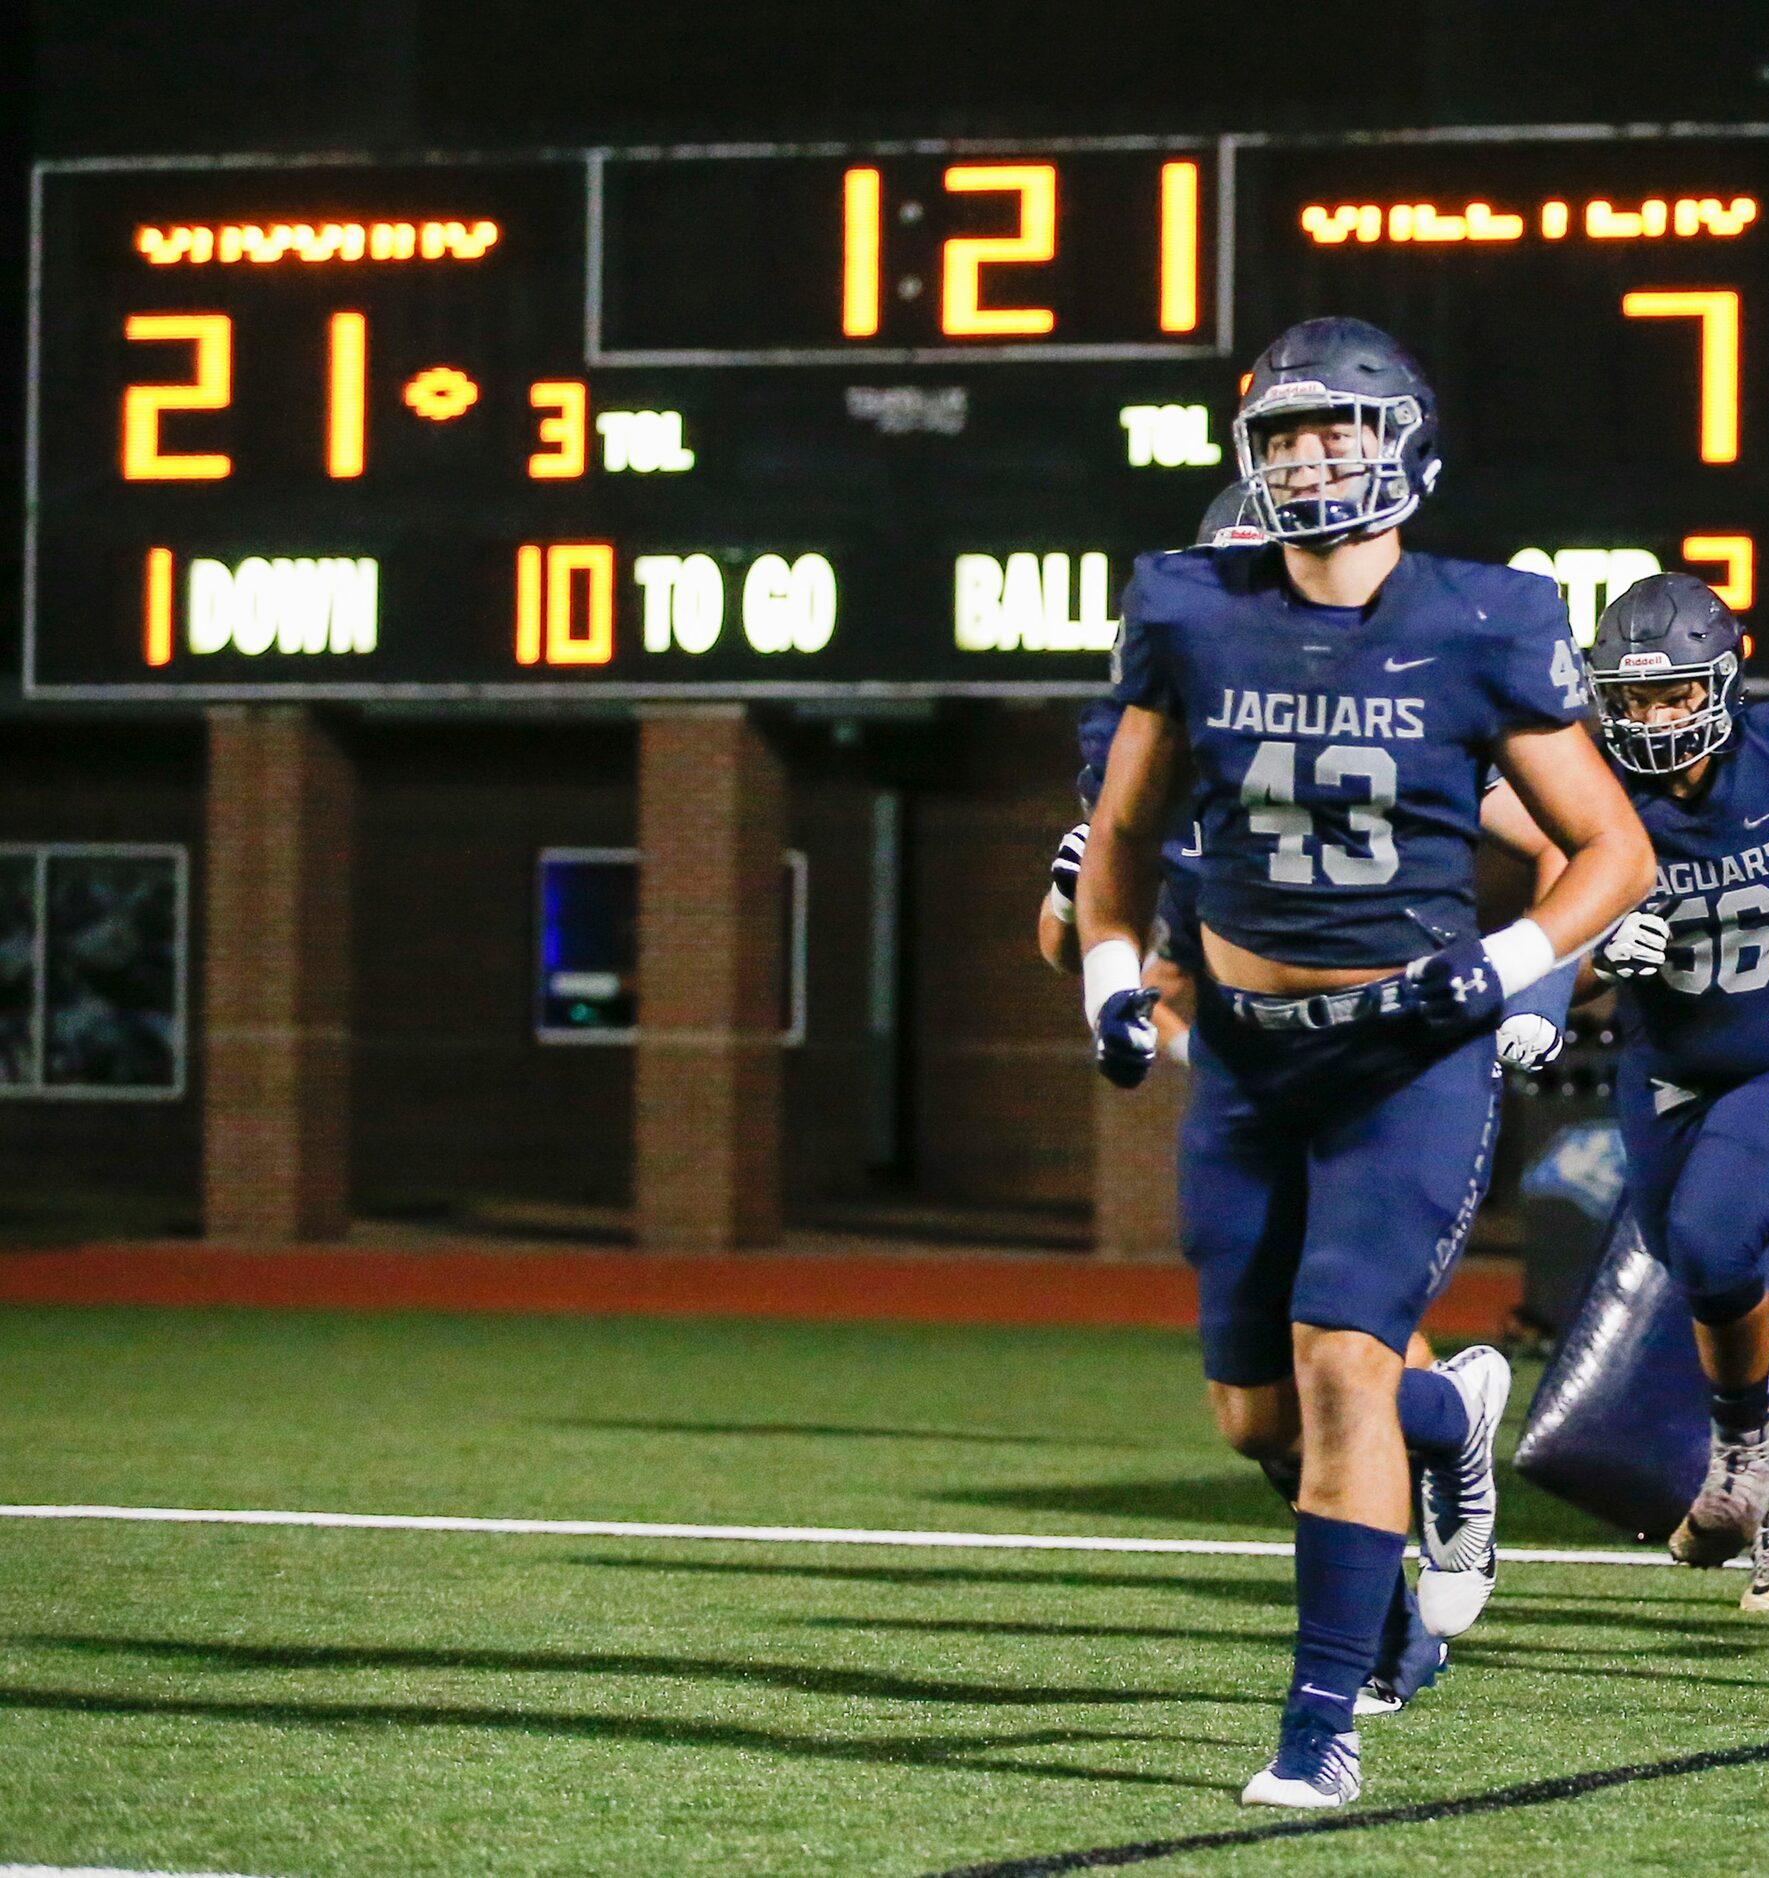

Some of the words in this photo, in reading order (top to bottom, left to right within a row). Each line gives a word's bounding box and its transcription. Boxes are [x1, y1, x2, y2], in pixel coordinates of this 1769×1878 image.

[121, 310, 368, 481] 21
[1621, 288, 1742, 465] 7
[528, 380, 588, 480] 3
[596, 409, 694, 472] TOL
[1119, 403, 1222, 468] TOL
[188, 556, 379, 656] DOWN
[515, 541, 616, 667] 10
[633, 553, 725, 655] TO
[741, 552, 837, 655] GO
[954, 552, 1121, 651] BALL
[1623, 655, 1662, 667] Riddell
[1207, 688, 1425, 739] JAGUARS
[1242, 741, 1399, 886] 43
